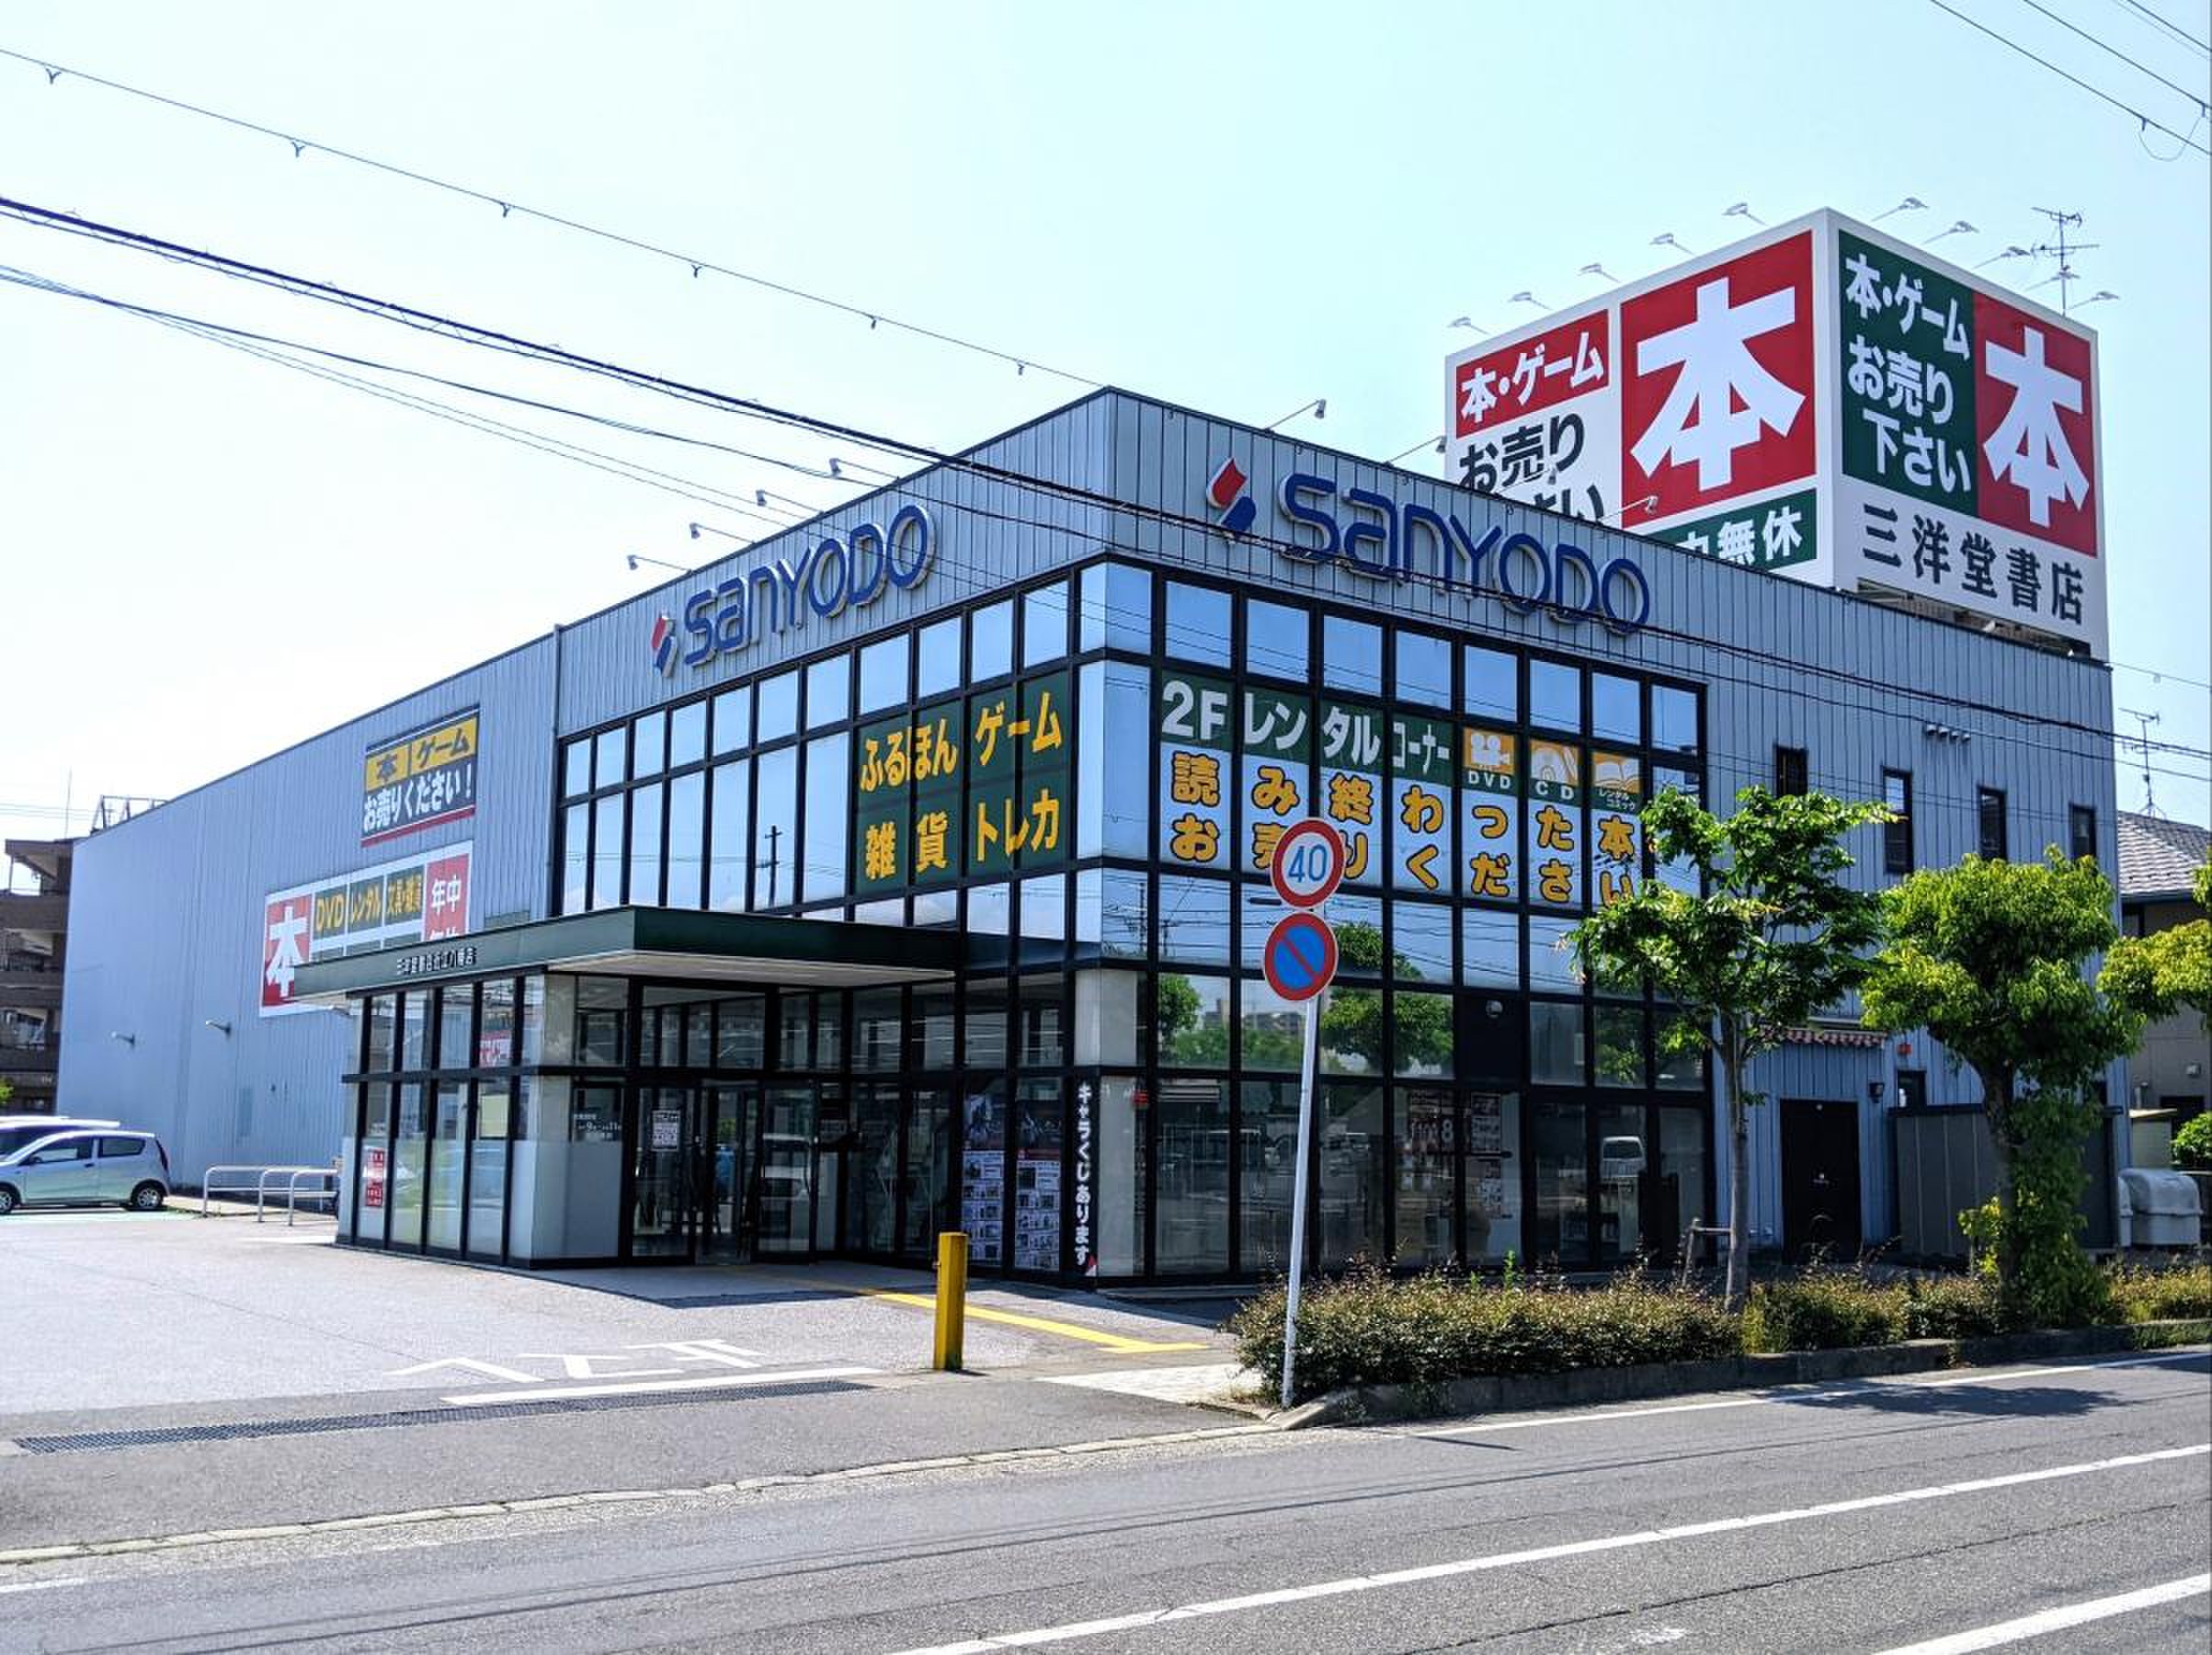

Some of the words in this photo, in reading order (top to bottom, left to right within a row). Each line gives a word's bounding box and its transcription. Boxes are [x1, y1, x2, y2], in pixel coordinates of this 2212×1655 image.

[1845, 252, 1970, 360] 本・ゲーム
[1459, 331, 1604, 424] 本・ゲーム
[1630, 276, 1806, 492] 本
[1848, 334, 1955, 426] お売り
[1458, 412, 1585, 492] お売り
[1864, 408, 1972, 495] 下さい
[1983, 325, 2090, 529] 本
[1863, 502, 2083, 627] 三洋堂書店
[376, 754, 398, 782] 本
[416, 727, 471, 769] ゲーム
[861, 719, 958, 792] ふるほん
[975, 691, 1063, 766] ゲーム
[1468, 770, 1511, 791] DVD
[866, 811, 948, 880] 雑貨
[976, 789, 1059, 862] トレカ
[1289, 843, 1328, 884] 40
[316, 892, 345, 932] DVD
[350, 885, 382, 923] レンタル
[431, 874, 462, 916] 年中
[266, 906, 308, 997] 本
[1074, 1081, 1093, 1265] キャラくじあります
